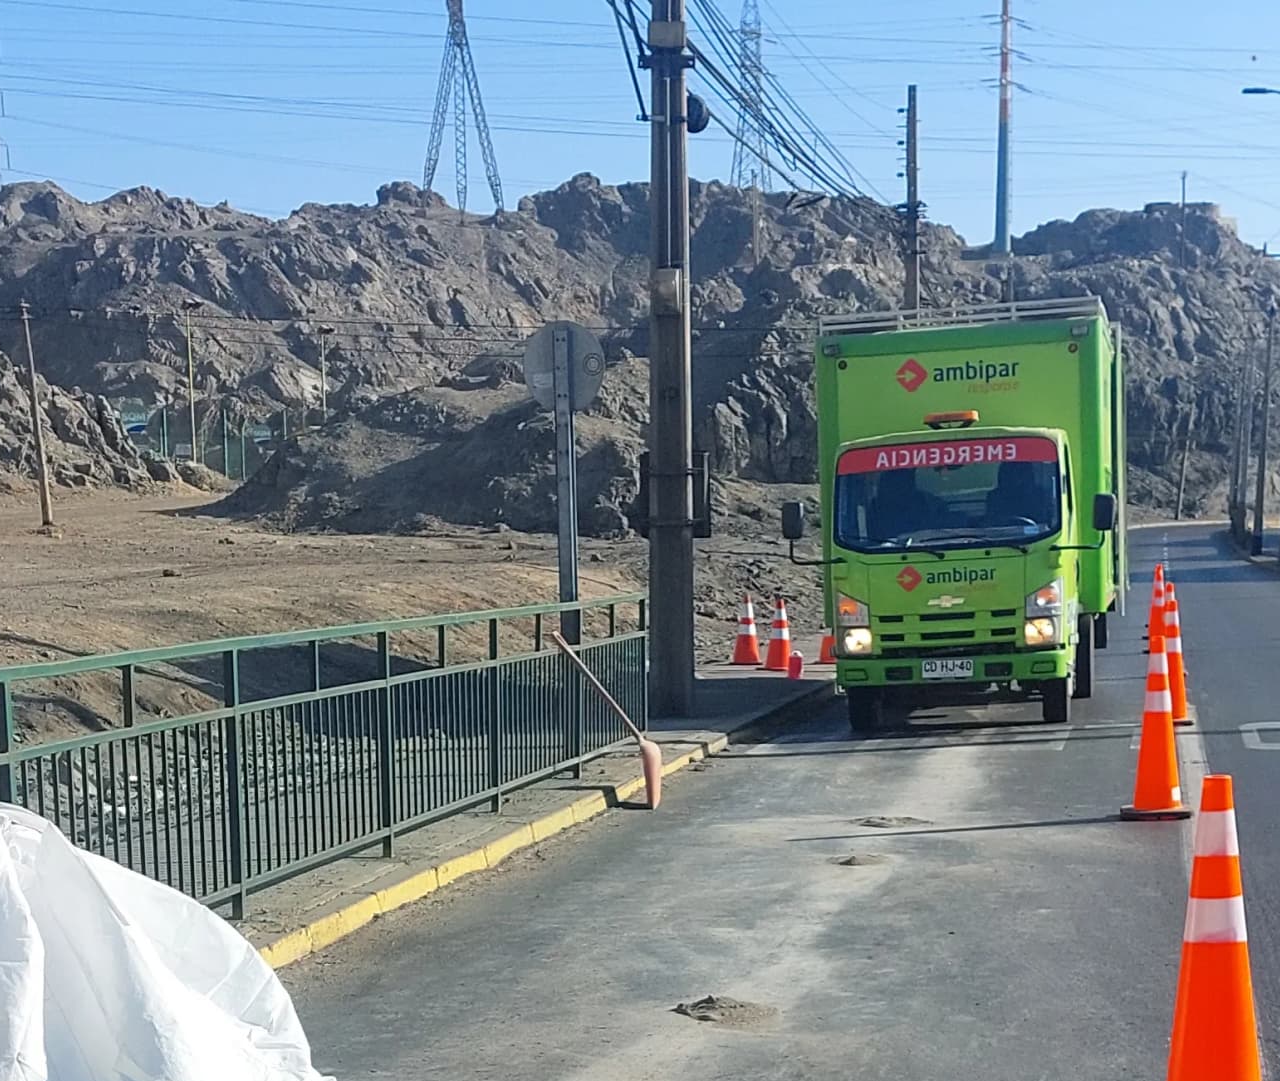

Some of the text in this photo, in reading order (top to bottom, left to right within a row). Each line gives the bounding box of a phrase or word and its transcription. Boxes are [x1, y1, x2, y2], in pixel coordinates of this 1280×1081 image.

[933, 360, 1019, 383] ambipar
[926, 567, 996, 585] ambipar
[924, 661, 937, 672] CD
